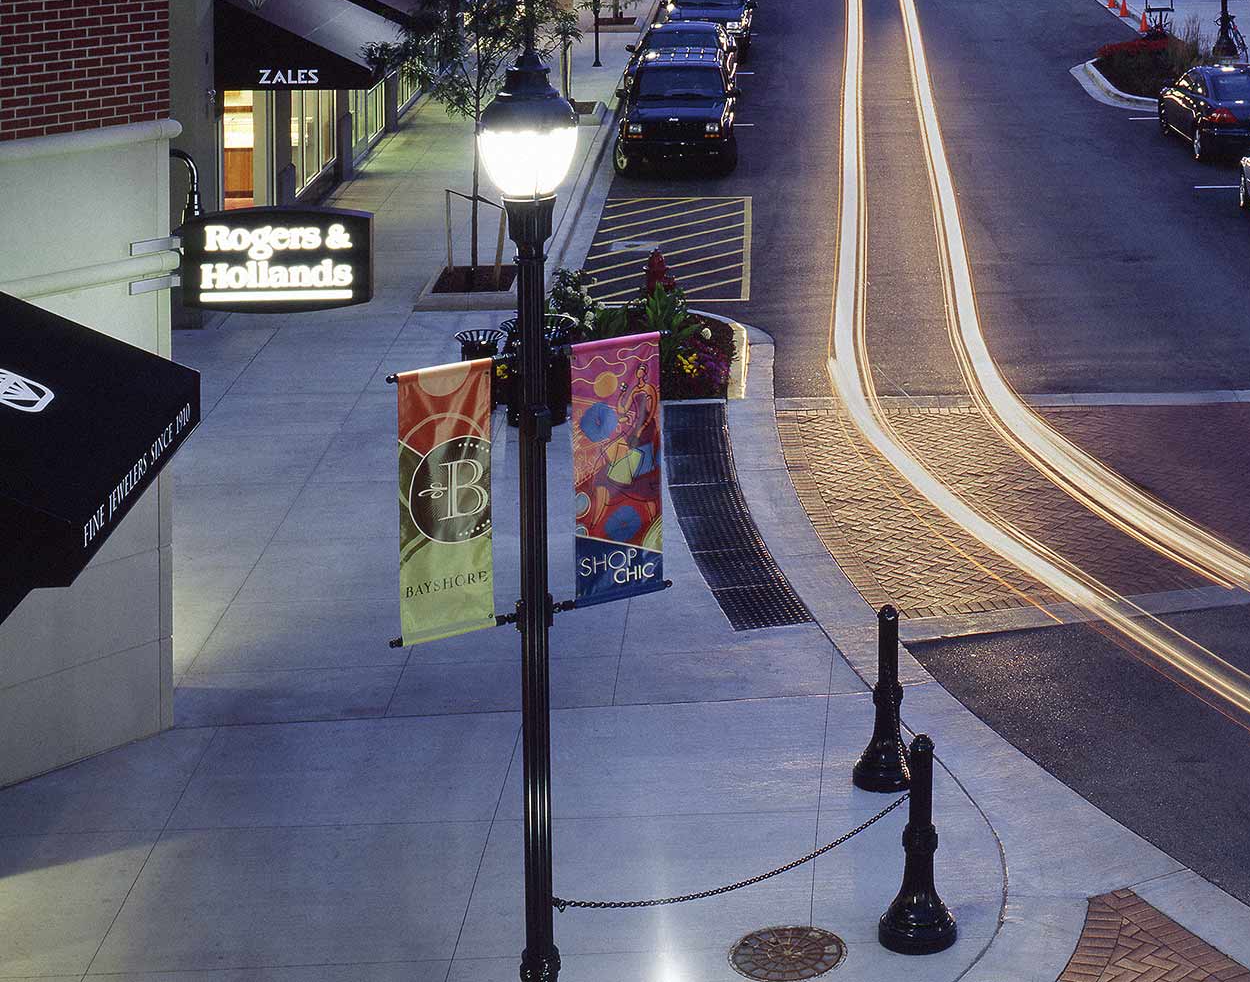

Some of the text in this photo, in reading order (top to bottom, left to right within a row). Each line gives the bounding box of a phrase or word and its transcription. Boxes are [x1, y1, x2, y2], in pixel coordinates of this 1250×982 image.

[259, 69, 319, 84] ZALES
[204, 223, 353, 260] Rogers &
[200, 259, 353, 289] Hollands
[84, 402, 191, 548] FINE JEWELERS SINCE 1910
[438, 458, 489, 522] B
[580, 548, 637, 577] SHOP
[614, 562, 655, 584] CHIC
[405, 570, 489, 599] BAYSHORE
